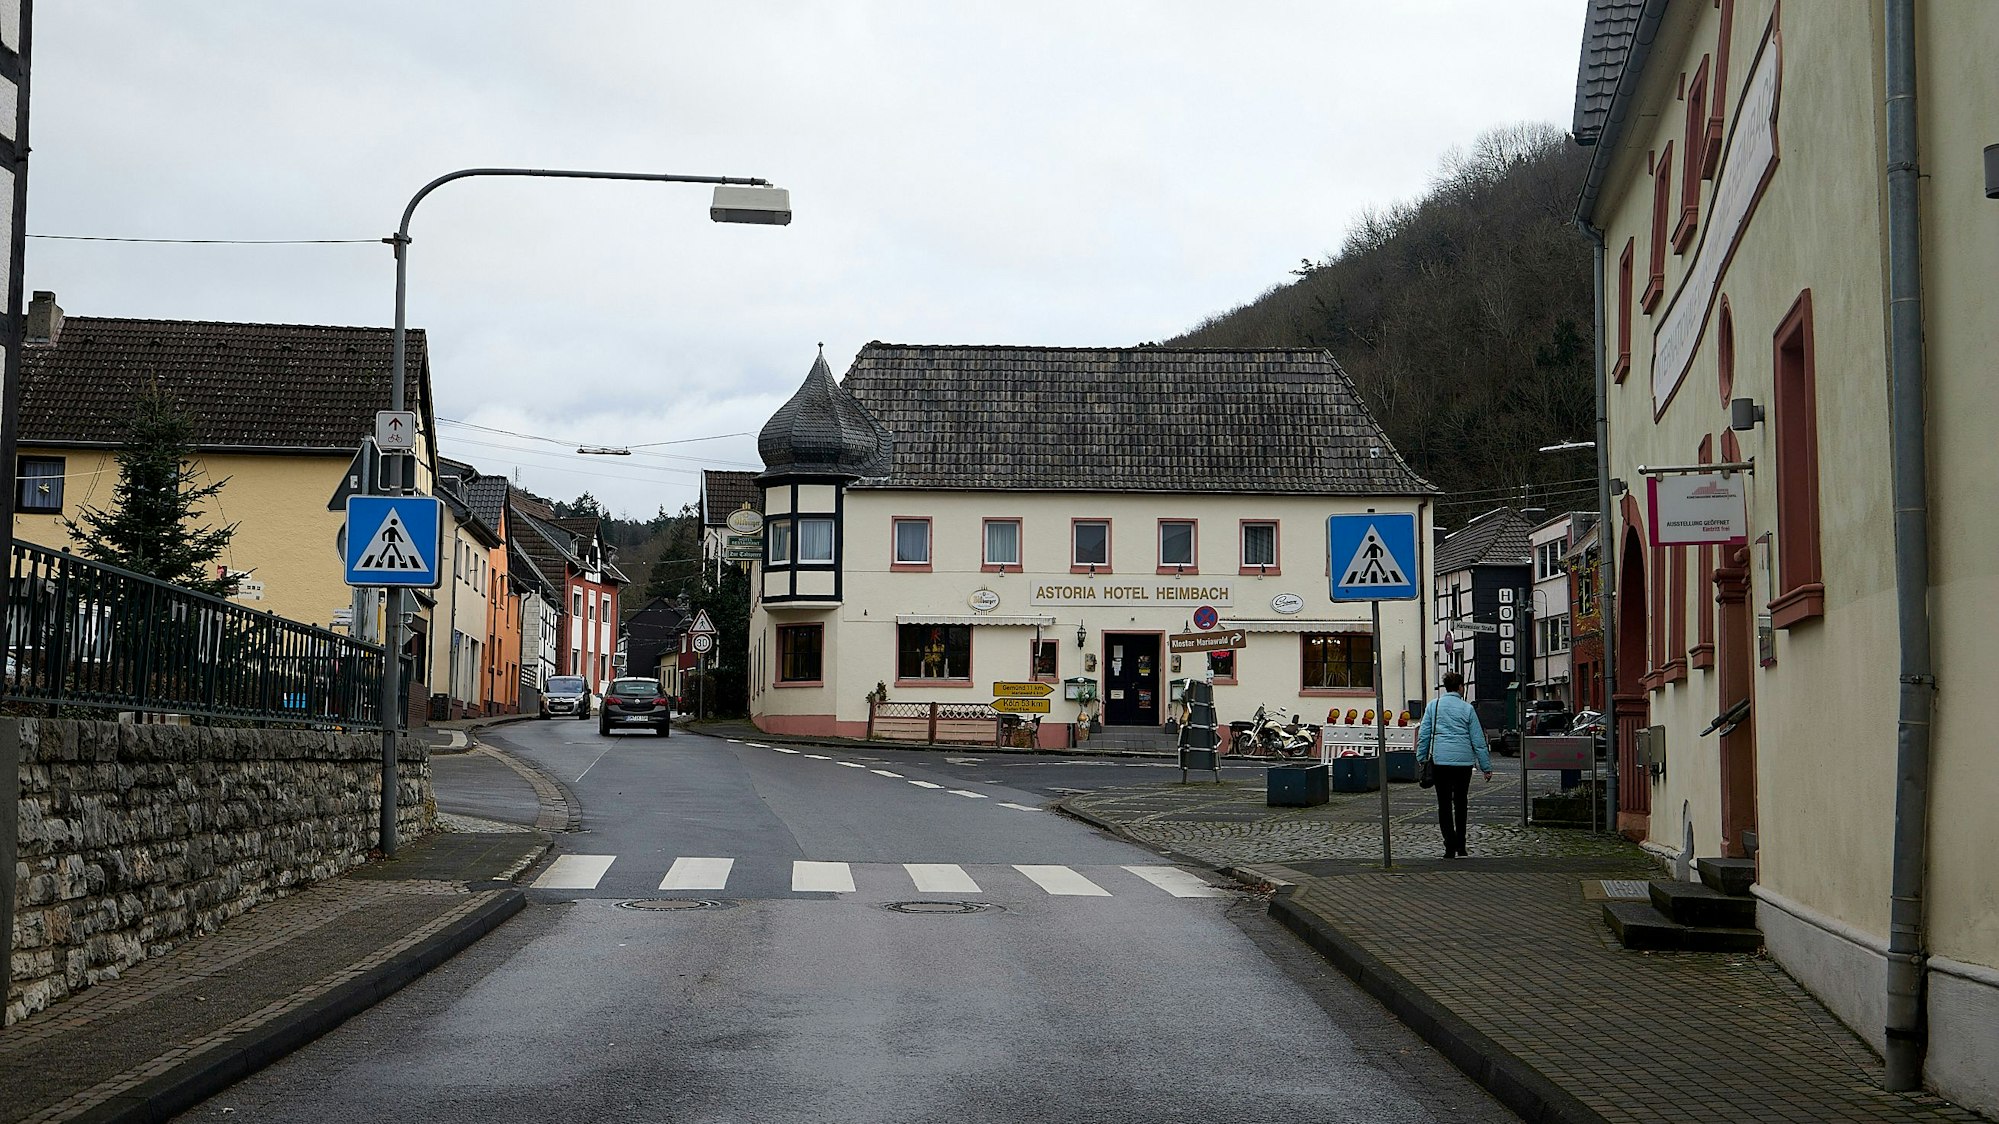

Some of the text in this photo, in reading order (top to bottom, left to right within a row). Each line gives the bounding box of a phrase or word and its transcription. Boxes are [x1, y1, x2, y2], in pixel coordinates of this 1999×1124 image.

[1036, 586, 1229, 600] ASTORIA HOTEL HEIMBACH
[697, 639, 707, 647] 30
[1171, 636, 1229, 648] Kloster Mariawald
[1003, 698, 1020, 707] Köln
